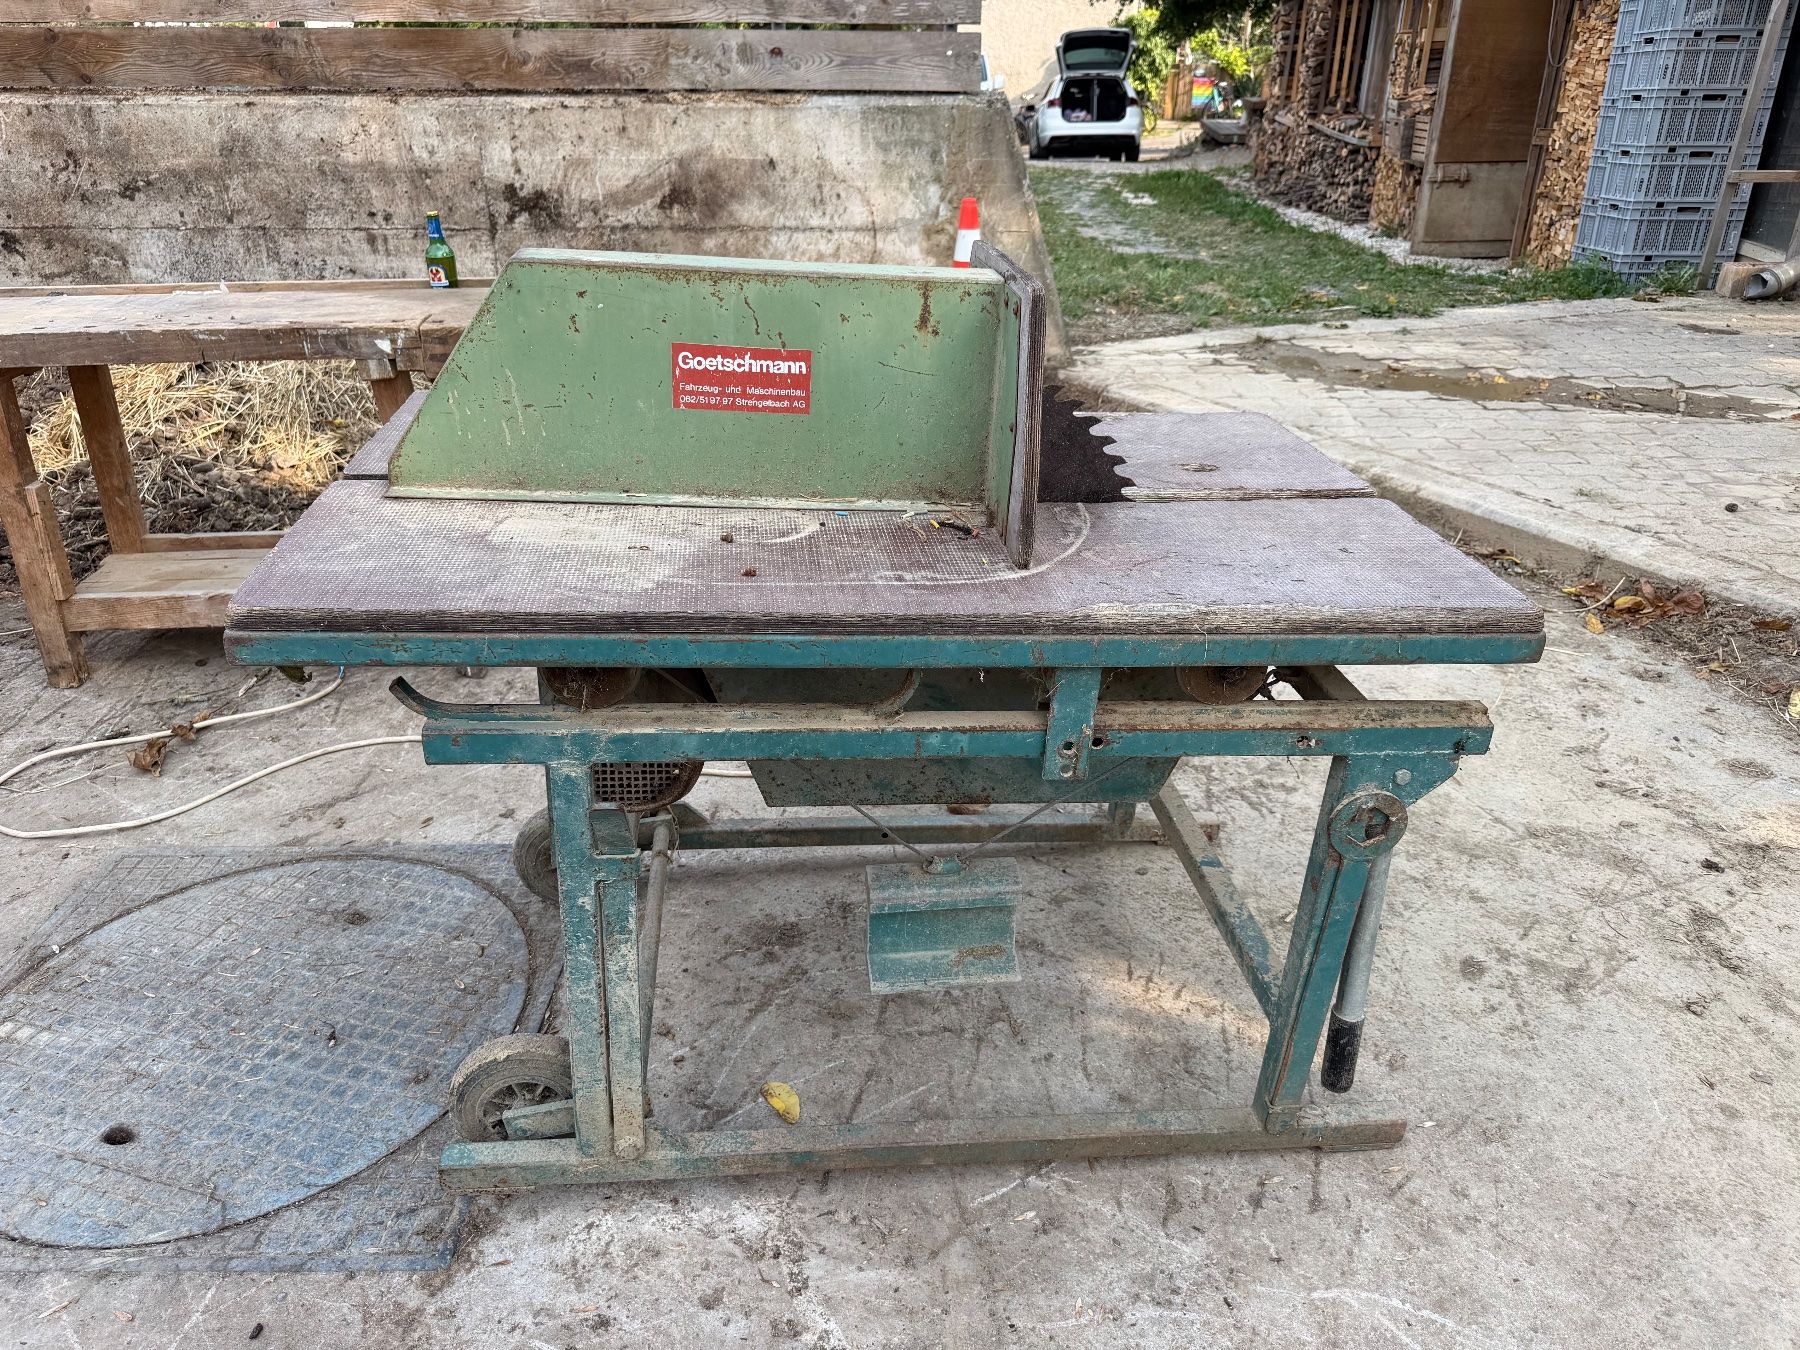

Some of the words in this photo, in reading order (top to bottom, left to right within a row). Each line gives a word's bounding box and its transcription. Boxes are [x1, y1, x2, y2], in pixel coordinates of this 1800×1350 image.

[678, 351, 807, 375] Goetschmann
[679, 382, 722, 394] Fahrzeug-
[725, 385, 741, 394] und
[746, 386, 806, 397] Maschinenbau
[735, 397, 790, 408] Strengelbach
[792, 400, 806, 409] AG
